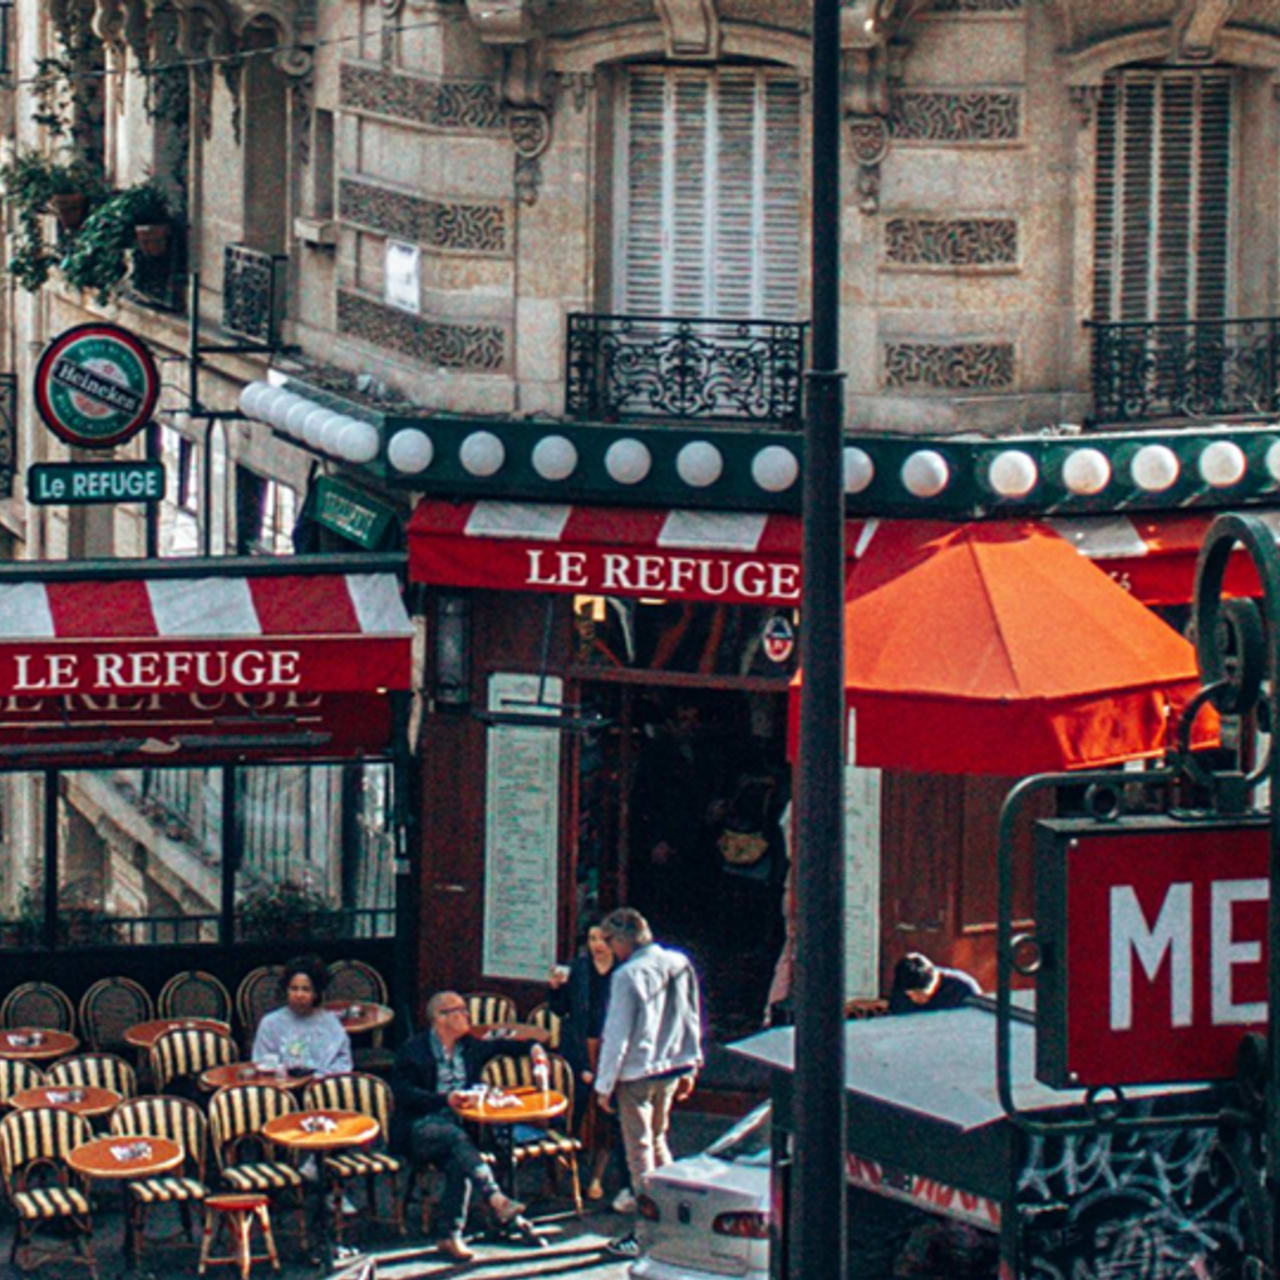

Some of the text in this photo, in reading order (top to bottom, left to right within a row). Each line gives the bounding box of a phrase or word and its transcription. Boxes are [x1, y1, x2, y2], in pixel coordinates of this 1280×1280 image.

[58, 365, 136, 410] Heineken
[40, 471, 157, 498] Le REFUGE
[526, 549, 800, 598] LE REFUGE
[13, 650, 302, 690] LE REFUGE
